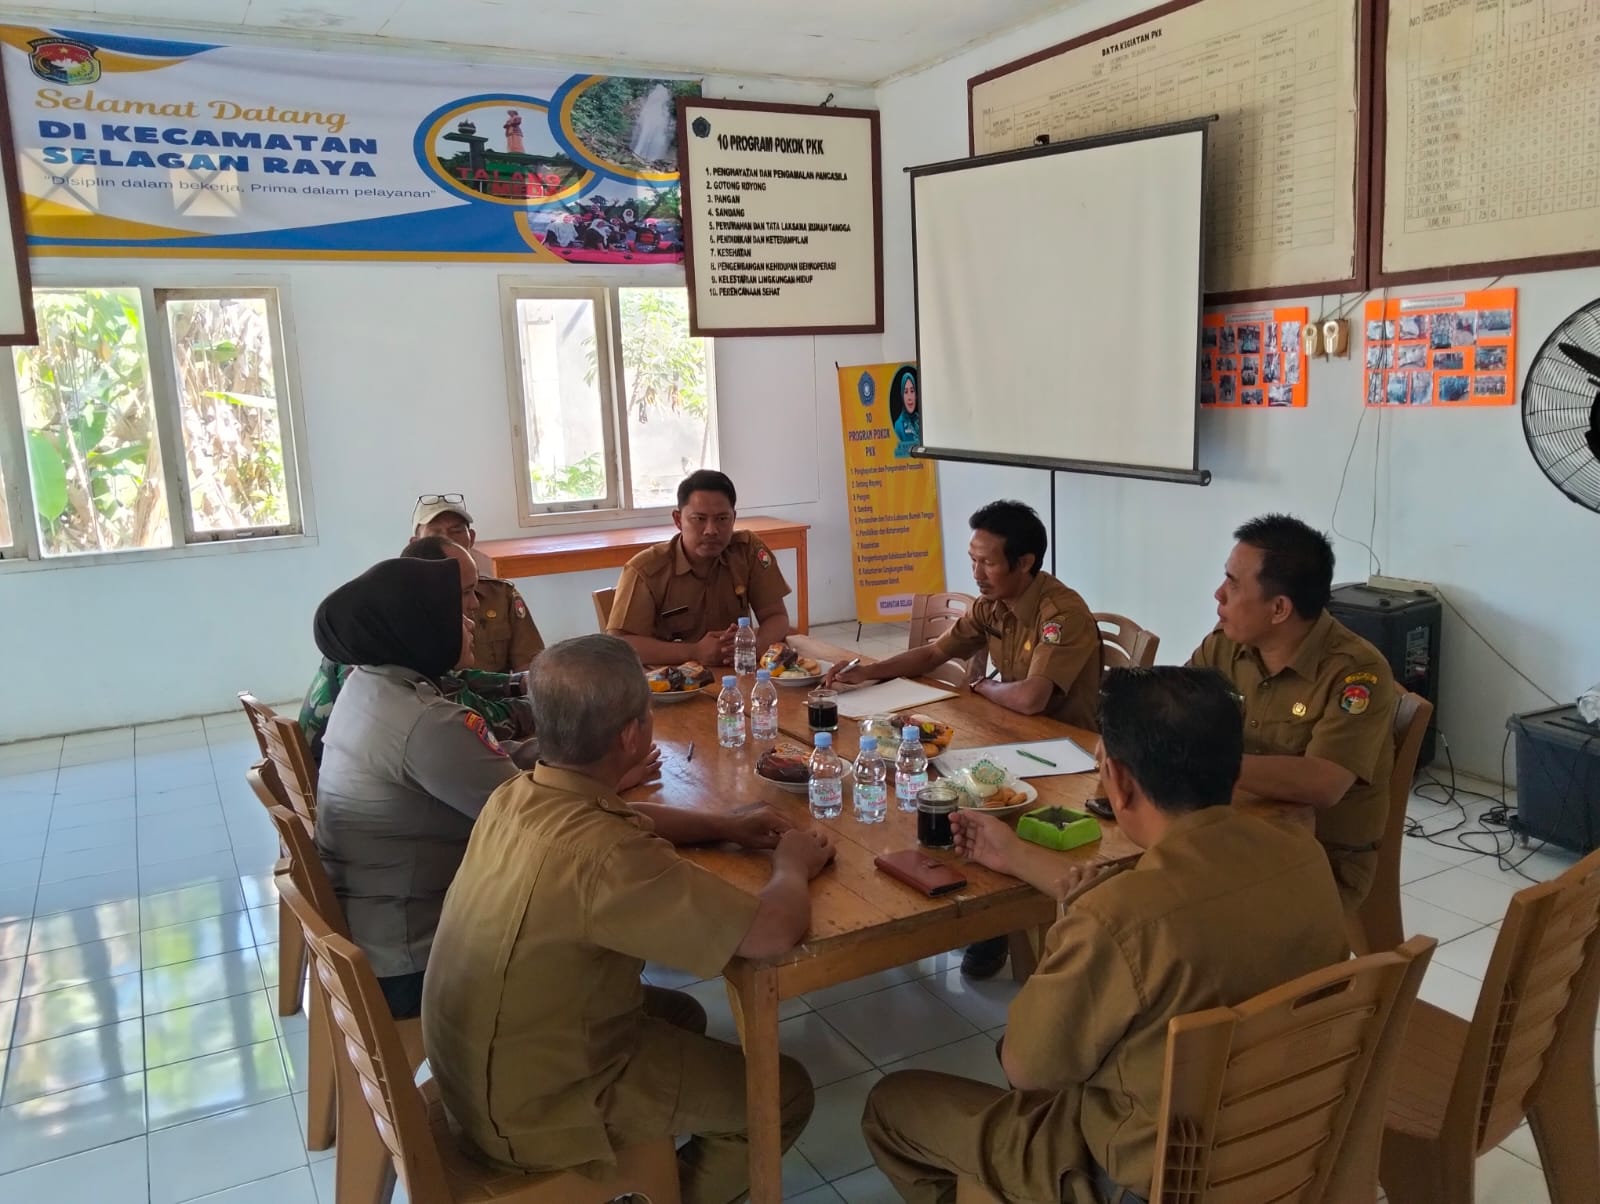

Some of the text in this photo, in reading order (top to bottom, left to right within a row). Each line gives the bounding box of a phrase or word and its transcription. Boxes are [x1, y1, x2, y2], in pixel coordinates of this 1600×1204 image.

[35, 88, 350, 133] Selamat Datang
[38, 119, 378, 155] DI KECAMATAN
[717, 133, 825, 155] 10 PROGRAM POKOK PKK
[42, 146, 377, 177] SELAGAN RAYA
[456, 167, 561, 185] TALANG
[705, 167, 848, 181] 1. PENGHAYATAN DAN PENGAMALAN PANCASILA
[44, 174, 437, 200] "Disiplin dalam bekerja, Prima dalam pelayanan"
[706, 181, 767, 191] 2. GOTONG ROYONG
[714, 194, 741, 204] PANGAN
[708, 208, 745, 217] 4. SANDANG
[709, 221, 715, 230] 5.
[753, 222, 765, 230] DAN
[766, 222, 780, 231] TATA
[781, 222, 807, 231] LAKSANA
[828, 223, 851, 232] TANGGA
[709, 235, 716, 244] 6.
[753, 235, 765, 244] DAN
[710, 248, 752, 257] 7. KESEHATAN
[765, 262, 798, 271] KEHIDUPAN
[758, 275, 796, 284] LINGKUNGAN
[762, 287, 781, 296] SEHAT
[865, 412, 873, 423] 10
[848, 428, 890, 441] PROGRAM POKOK
[865, 445, 876, 457] PKK
